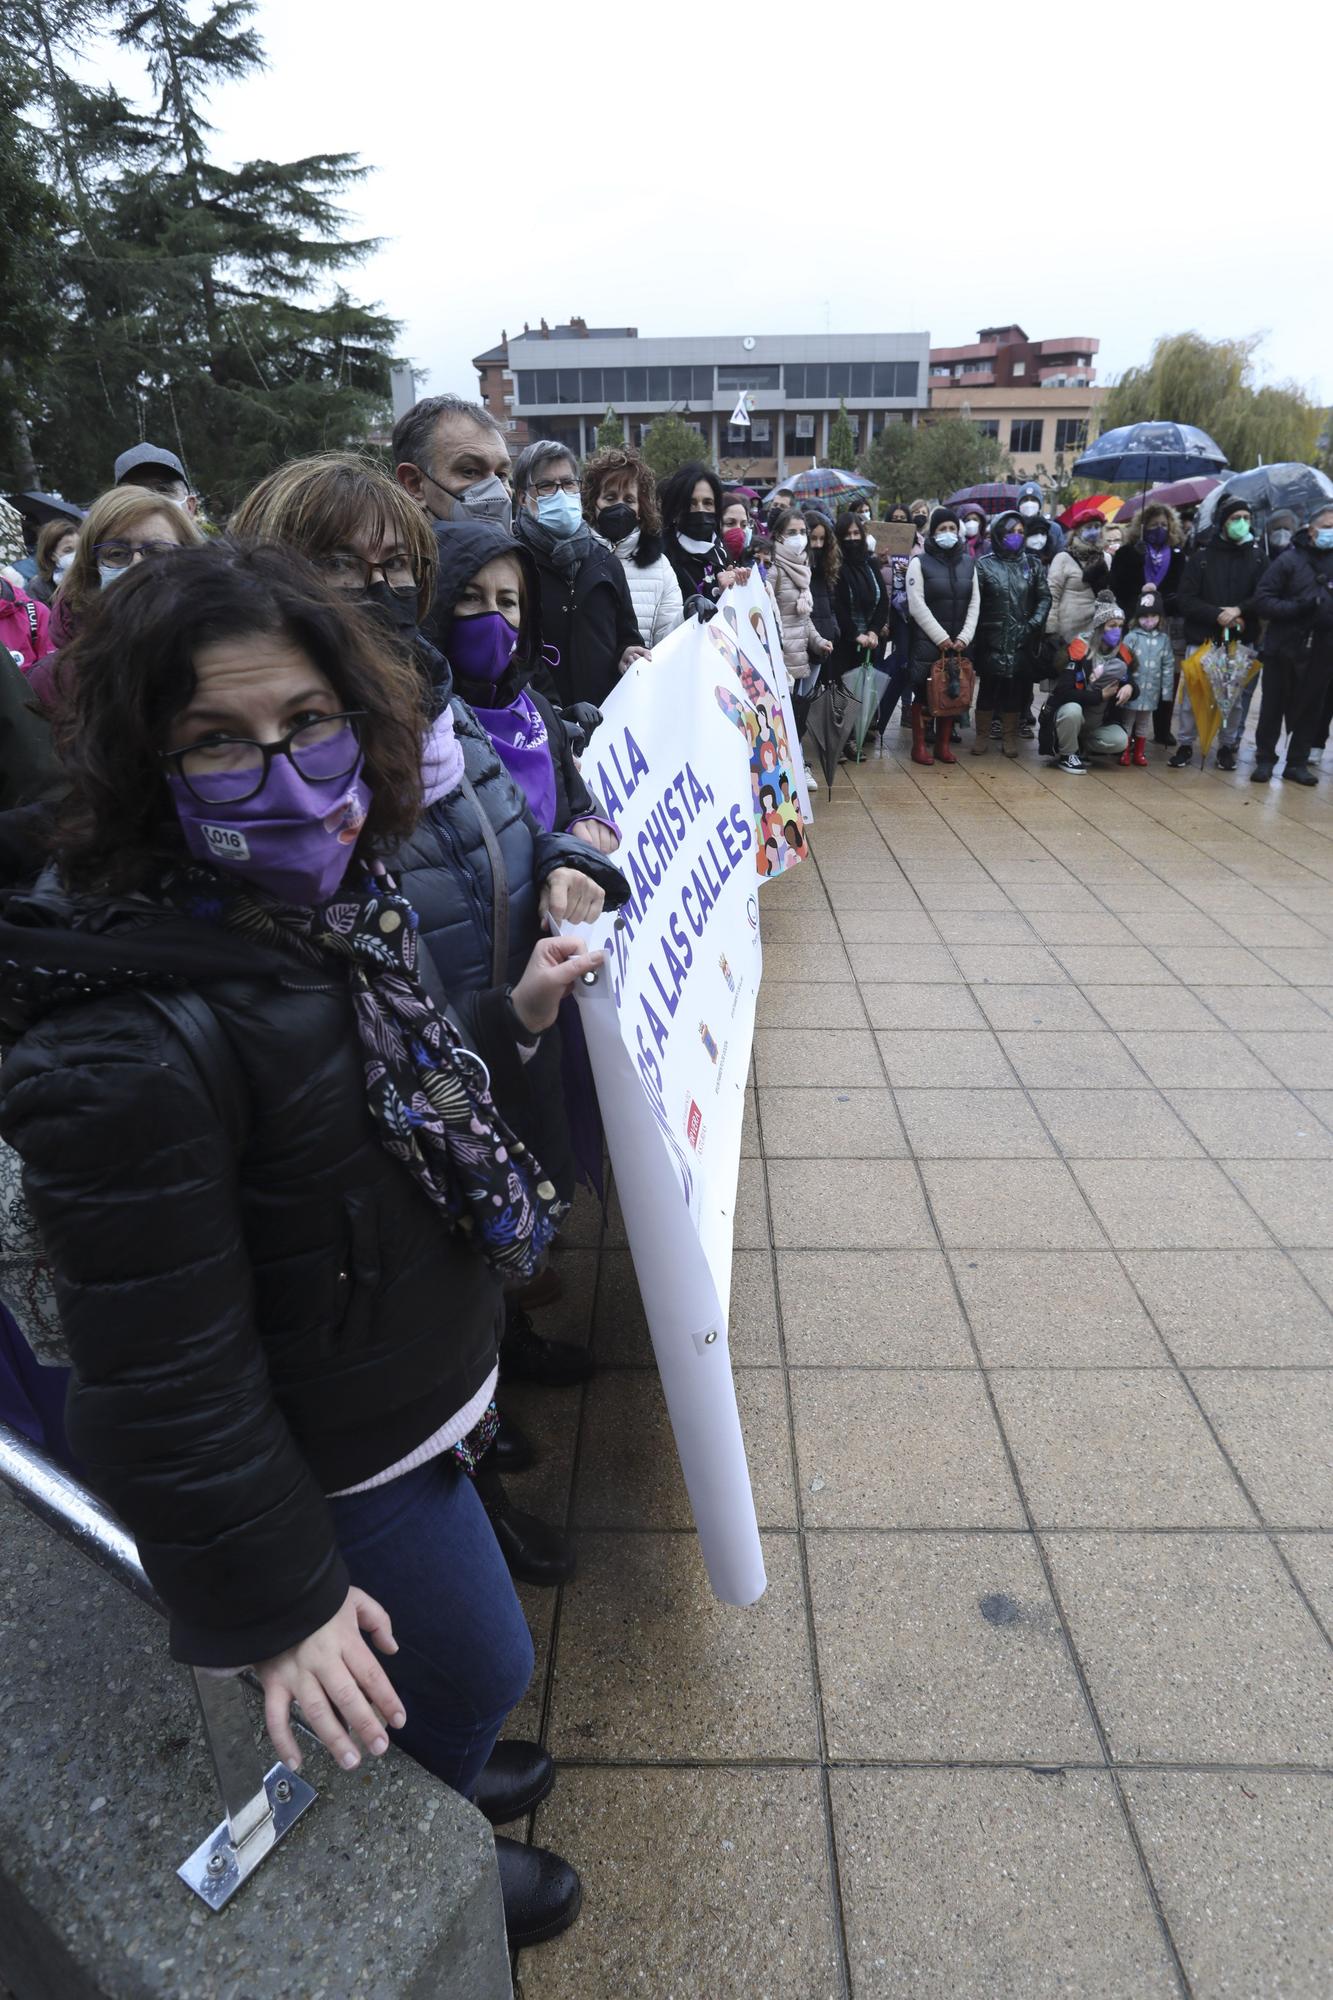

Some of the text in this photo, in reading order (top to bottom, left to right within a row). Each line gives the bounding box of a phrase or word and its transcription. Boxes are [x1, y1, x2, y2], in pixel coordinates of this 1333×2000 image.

[597, 726, 650, 823] A LA
[212, 829, 241, 848] 016
[681, 803, 751, 938] CALLES
[648, 911, 693, 1018] LAS
[639, 991, 669, 1060] A
